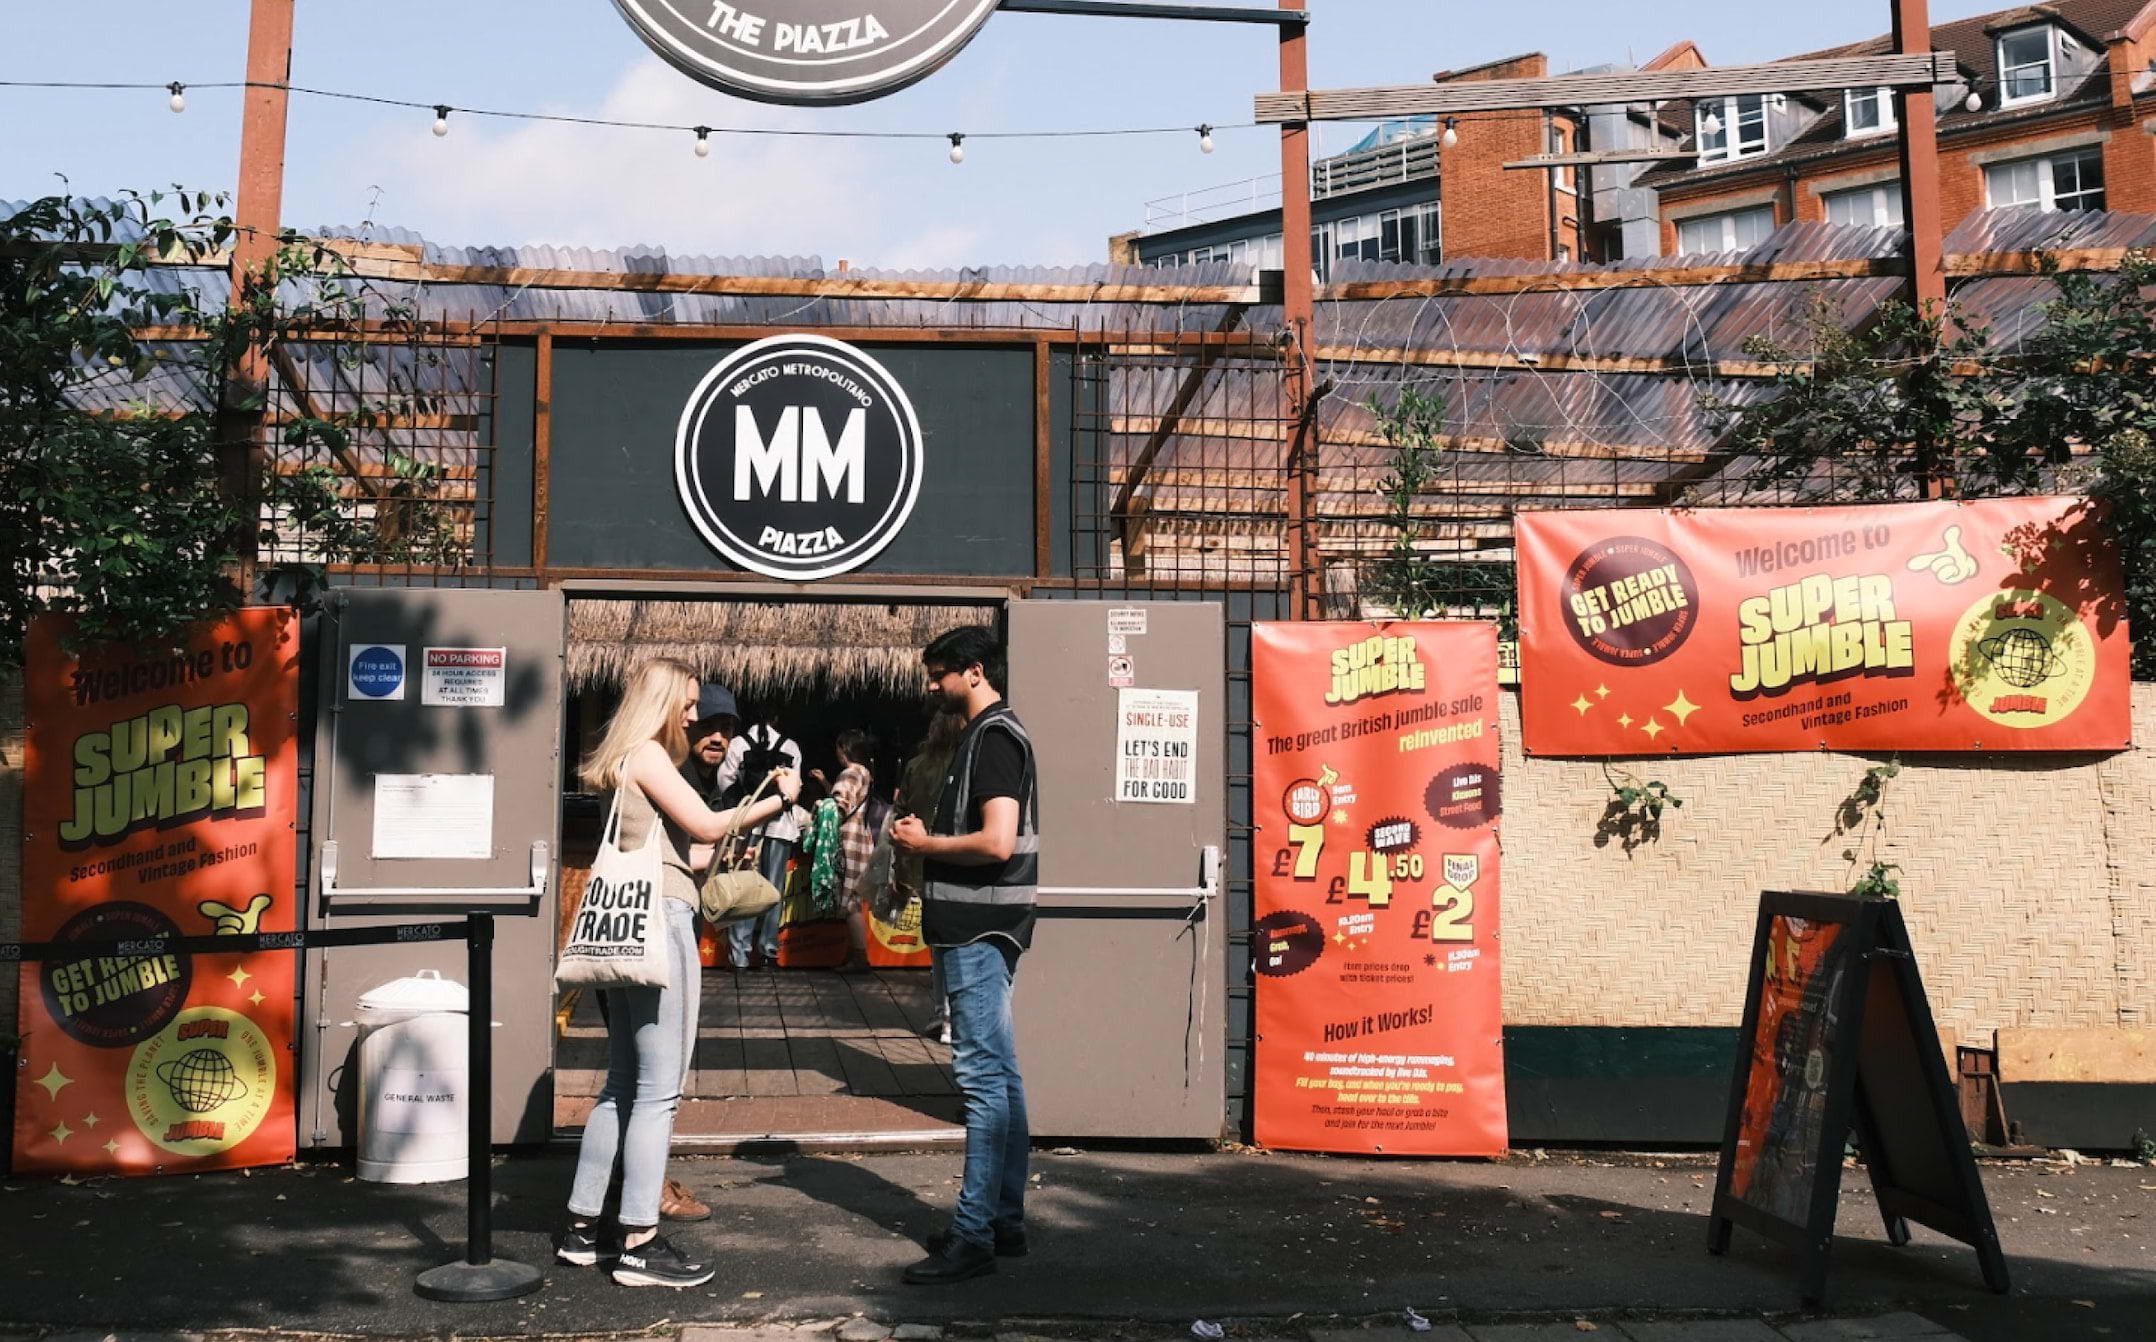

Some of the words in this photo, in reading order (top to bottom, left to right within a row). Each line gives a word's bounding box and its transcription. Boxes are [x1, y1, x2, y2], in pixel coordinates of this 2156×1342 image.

[707, 0, 766, 46] THE
[774, 14, 889, 53] PIAZZA
[729, 366, 780, 398] MERCATO
[783, 362, 873, 407] METROPOLITANO
[734, 404, 866, 504] MM
[757, 525, 845, 555] PIAZZA
[1615, 544, 1639, 554] SUPER
[1640, 546, 1669, 565] JUMBLE
[1735, 529, 1857, 578] Welcome
[1862, 524, 1890, 550] to
[1570, 585, 1611, 617] GET
[1610, 563, 1679, 605] READY
[1577, 614, 1607, 638] TO
[1610, 583, 1689, 630] JUMBLE
[1739, 572, 1897, 645] SUPER
[430, 654, 447, 663] NO
[450, 654, 500, 664] PARKING
[1331, 635, 1417, 675] SUPER
[1620, 649, 1643, 659] SUPER
[1729, 620, 1915, 700] JUMBLE
[75, 651, 216, 705] Welcome
[221, 641, 251, 671] to
[358, 661, 377, 671] Fire
[379, 661, 397, 670] exit
[352, 672, 377, 684] keep
[377, 673, 403, 682] clear
[1324, 662, 1425, 705] JUMBLE
[441, 695, 469, 703] THANK
[1742, 696, 1824, 727] Secondhand
[1826, 692, 1852, 709] and
[1801, 710, 1852, 730] Vintage
[1855, 698, 1909, 720] Fashion
[1126, 712, 1190, 728] SINGLE-USE
[1267, 736, 1293, 755] The
[1297, 725, 1338, 751] great
[1341, 713, 1391, 740] British
[1394, 701, 1448, 730] jumble
[1450, 695, 1483, 716] sale
[74, 702, 250, 787] SUPER
[1399, 718, 1484, 753] reinvented
[1125, 740, 1159, 757] LET'S
[1164, 741, 1188, 758] END
[1125, 758, 1140, 778] THE
[1124, 780, 1148, 797] FOR
[1153, 781, 1187, 799] GOOD
[1453, 777, 1468, 788] Live
[1468, 773, 1482, 785] DJs
[59, 755, 266, 846] JUMBLE
[1333, 794, 1357, 806] Entry
[1440, 804, 1463, 817] Street
[1463, 800, 1482, 812] Food
[1292, 801, 1320, 818] BIRD
[1374, 822, 1411, 838] SECOND
[1374, 833, 1412, 849] WAVE
[69, 845, 165, 882] Secondhand
[168, 836, 197, 857] and
[1271, 823, 1326, 881] £7
[138, 858, 197, 884] Vintage
[199, 842, 258, 868] Fashion
[1447, 857, 1475, 872] FINAL
[1447, 868, 1475, 881] DROP
[1410, 883, 1475, 944] £2
[260, 933, 305, 945] MERCATO
[397, 925, 441, 937] MERCATO
[1349, 924, 1375, 936] Entry
[118, 939, 164, 951] MERCATO
[52, 958, 96, 994] GET
[1344, 962, 1362, 971] Item
[1363, 963, 1389, 972] prices
[1391, 963, 1410, 973] drop
[1448, 961, 1473, 973] Entry
[58, 992, 90, 1017] TO
[95, 954, 181, 1006] JUMBLE
[1340, 974, 1357, 983] with
[1359, 974, 1384, 983] ticket
[1323, 1021, 1358, 1043] How
[1362, 1015, 1375, 1035] it
[1377, 1004, 1433, 1033] Works!
[141, 1035, 166, 1070] PLANET
[240, 1030, 258, 1049] ONE
[252, 1048, 268, 1084] JUMBLE
[1315, 1052, 1348, 1063] minutes
[1347, 1053, 1358, 1063] of
[1358, 1052, 1407, 1066] high-energy
[136, 1072, 147, 1090] THE
[1385, 1067, 1397, 1078] by
[1397, 1067, 1412, 1078] live
[1296, 1077, 1309, 1088] Fill
[1308, 1079, 1328, 1089] your
[1345, 1080, 1362, 1089] and
[1362, 1080, 1384, 1090] when
[1411, 1081, 1436, 1093] ready
[1435, 1082, 1446, 1092] to
[384, 1093, 425, 1103] GENERAL
[425, 1093, 456, 1102] WASTE
[1337, 1092, 1359, 1103] head
[1359, 1093, 1377, 1103] over
[1377, 1093, 1388, 1103] to
[1387, 1093, 1402, 1104] the
[137, 1092, 160, 1127] SAVING
[1312, 1105, 1331, 1115] Then,
[1333, 1106, 1356, 1115] stash
[1356, 1107, 1375, 1117] your
[1376, 1107, 1396, 1117] haul
[1396, 1108, 1405, 1117] or
[1405, 1108, 1424, 1118] grab
[1432, 1108, 1449, 1118] bite
[1325, 1119, 1341, 1128] and
[1340, 1119, 1357, 1129] join
[1357, 1120, 1370, 1129] for
[1370, 1120, 1384, 1129] the
[1385, 1121, 1404, 1130] next
[620, 1253, 646, 1269] HOKA
